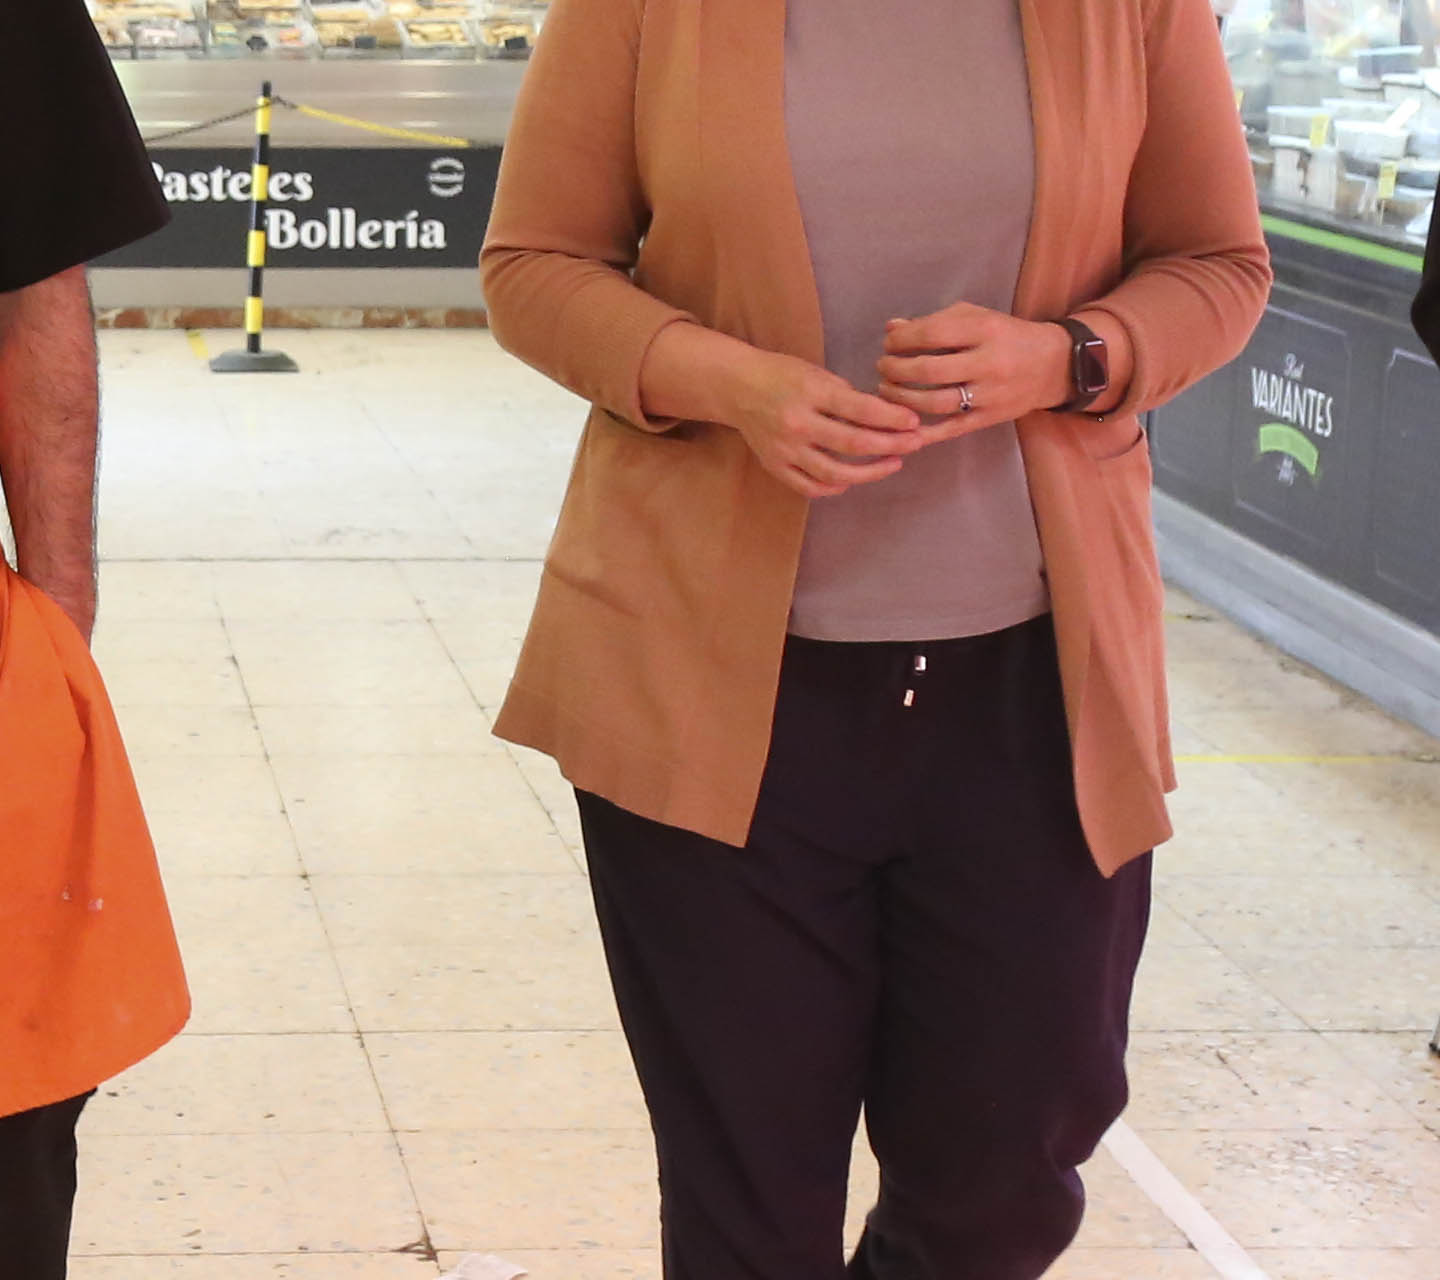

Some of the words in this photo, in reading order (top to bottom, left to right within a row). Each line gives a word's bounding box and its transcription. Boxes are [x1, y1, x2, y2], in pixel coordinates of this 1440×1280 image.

[151, 162, 314, 201] astees
[264, 207, 447, 250] Bollería
[1251, 368, 1334, 438] VARIANTES
